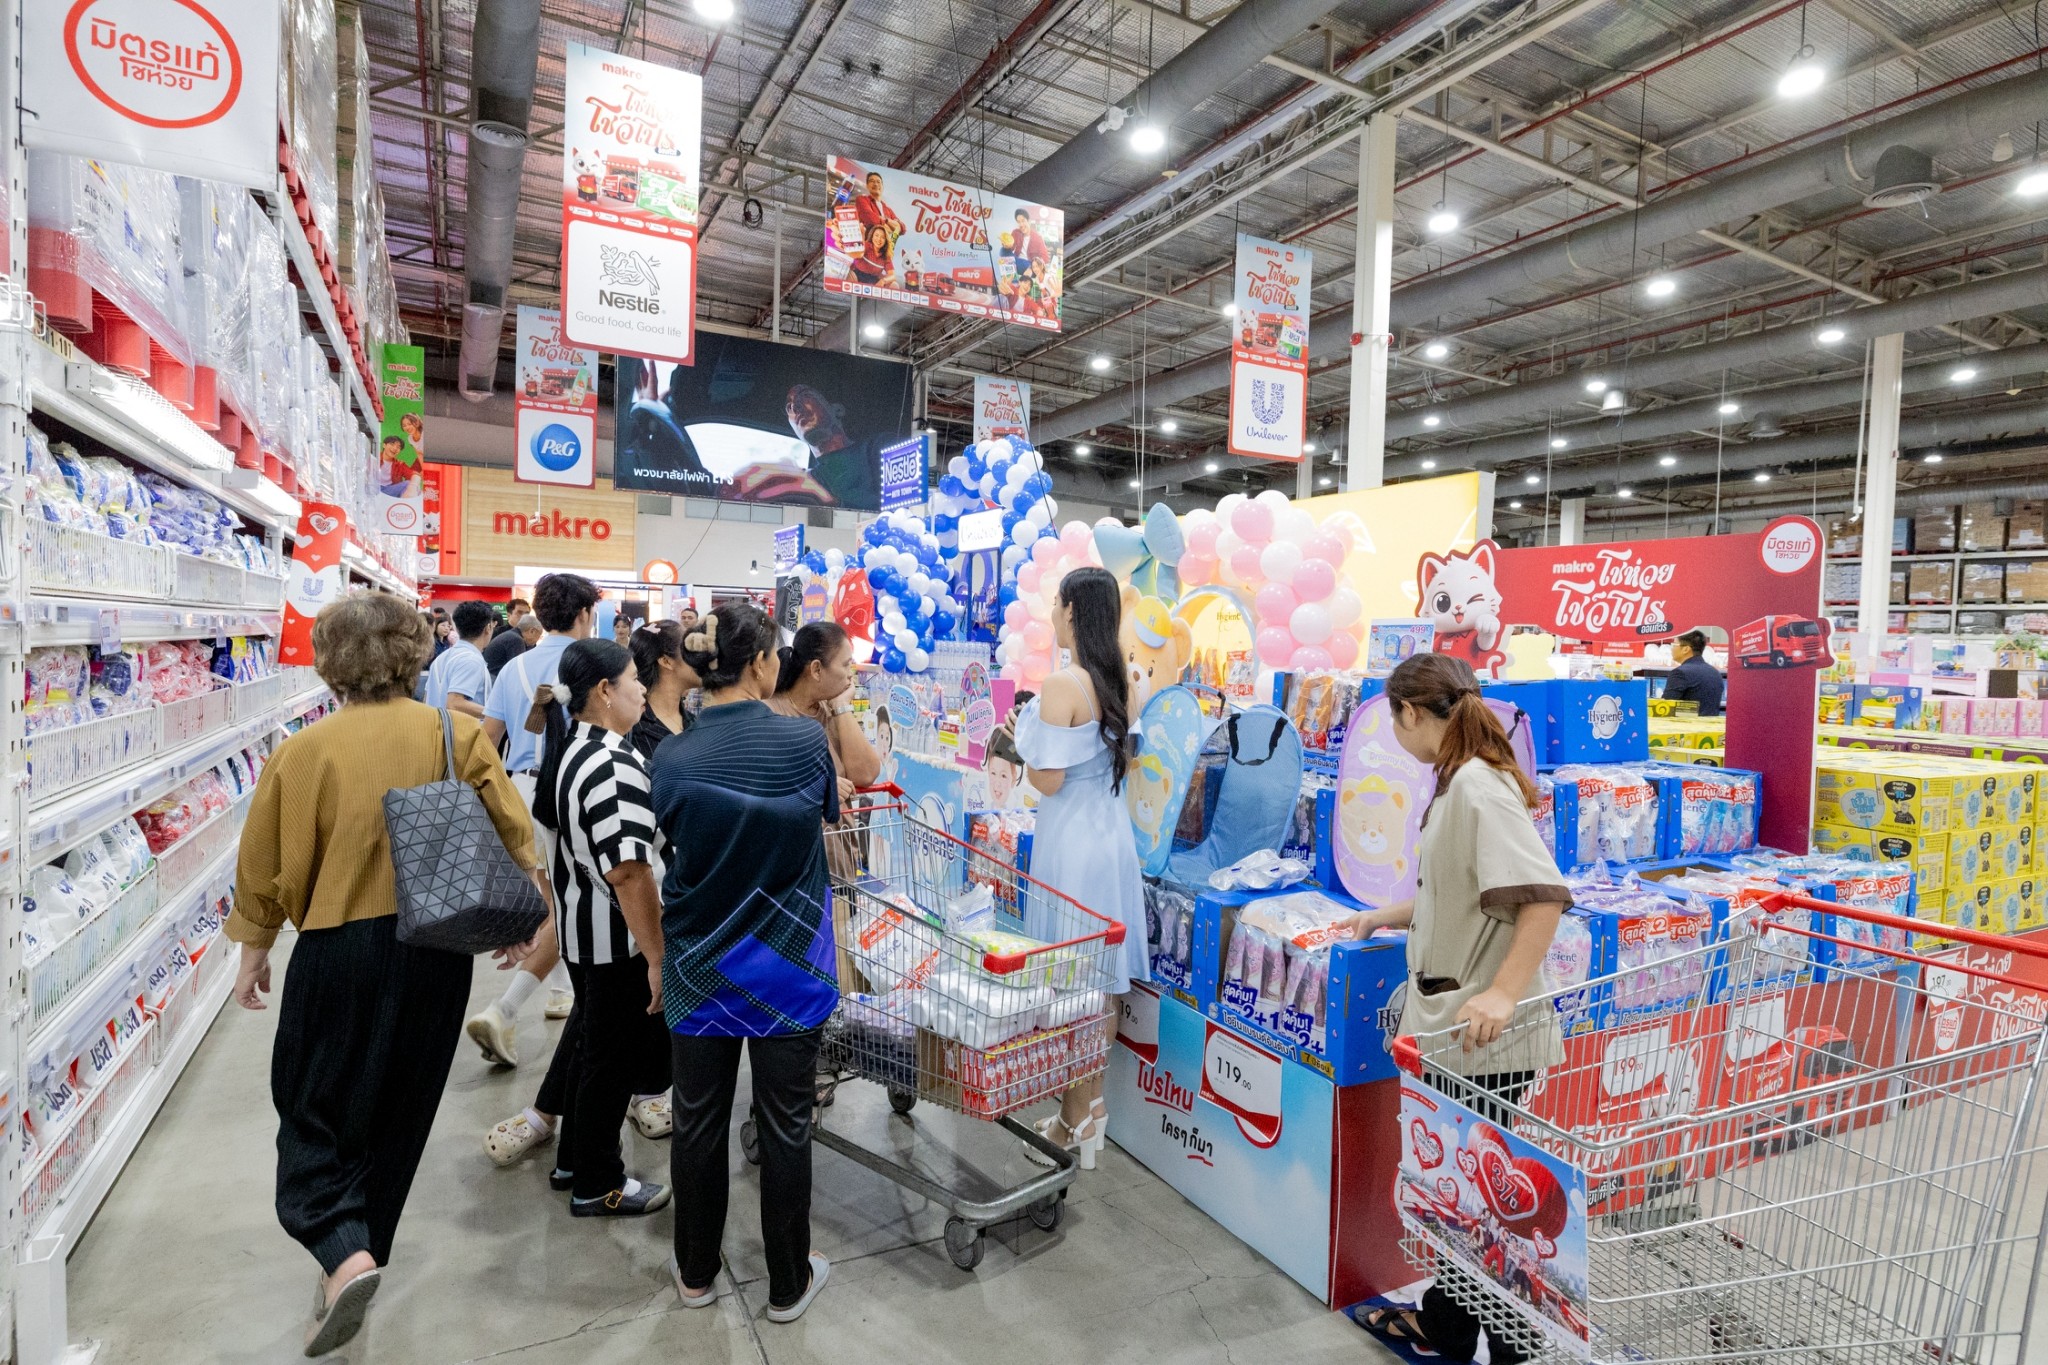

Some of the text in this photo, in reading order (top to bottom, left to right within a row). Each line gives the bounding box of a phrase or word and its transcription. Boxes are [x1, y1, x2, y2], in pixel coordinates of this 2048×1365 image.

[91, 17, 220, 81] มิตรแท้
[119, 56, 193, 91] โชห่วย
[602, 61, 642, 80] makro
[908, 185, 940, 198] makro
[1256, 246, 1279, 257] makro
[575, 311, 682, 338] Good food, Good life
[1246, 426, 1288, 441] Unilever
[540, 438, 577, 457] P&G
[633, 465, 711, 484] พวงมาลัยไฟฟ้า
[493, 508, 612, 541] makro
[1767, 537, 1812, 553] มิตรแท้
[1552, 548, 1677, 590] makro โชห่วย
[1409, 626, 1426, 634] 499
[1588, 710, 1623, 725] Hygiene
[1224, 984, 1254, 1004] สุดคุ้ม!
